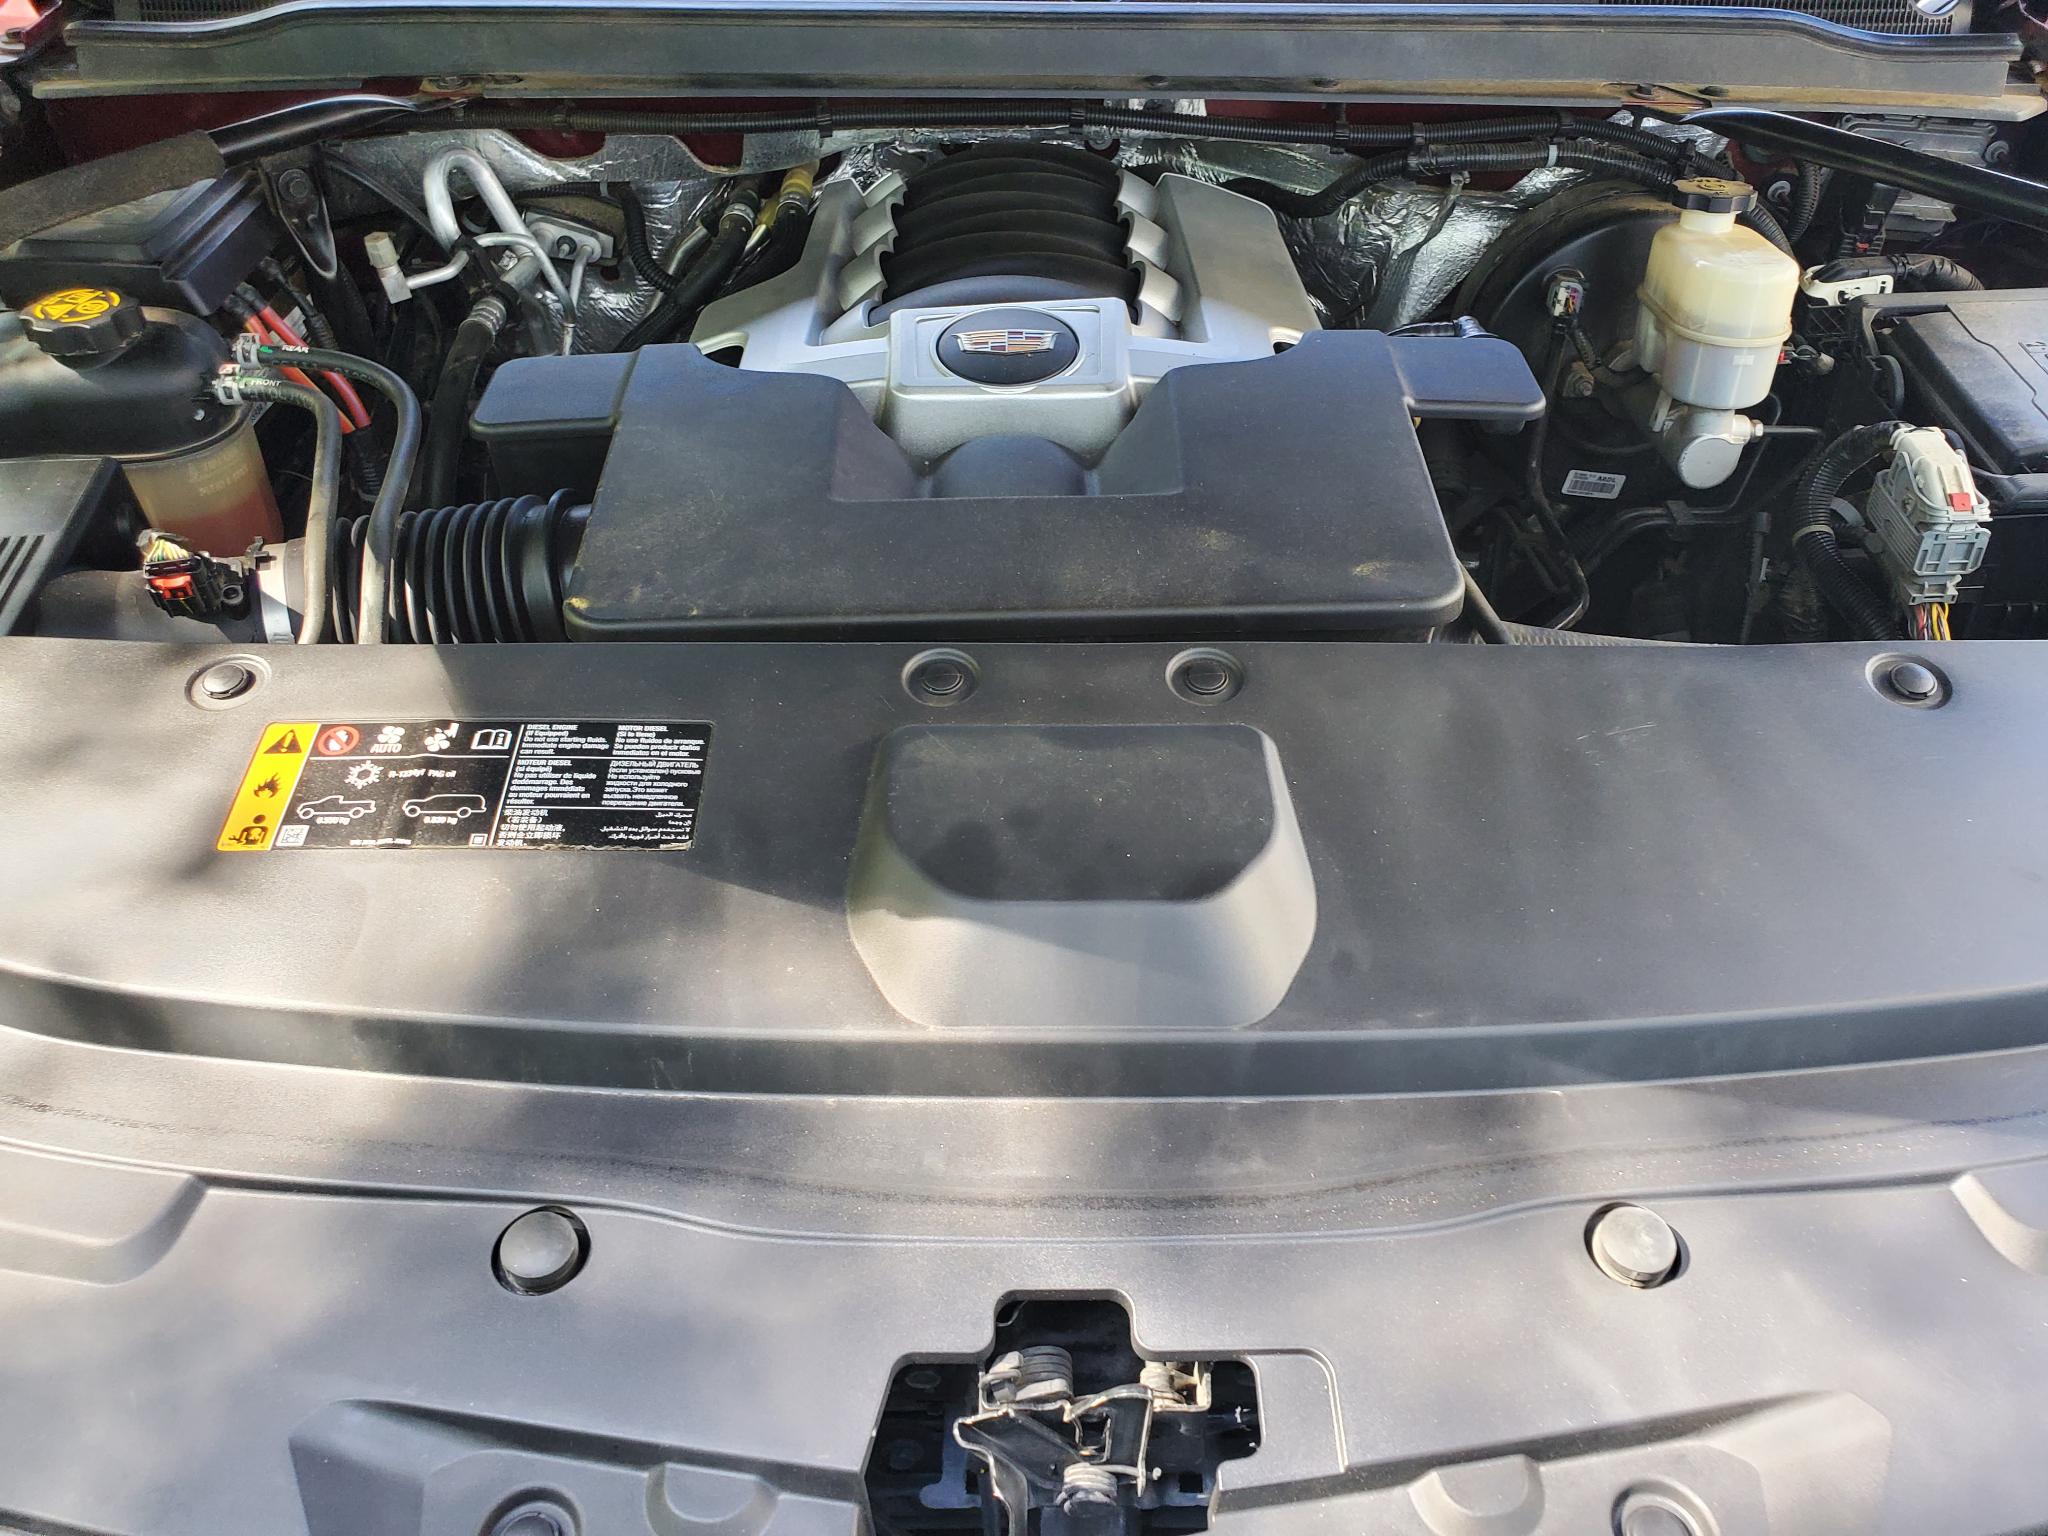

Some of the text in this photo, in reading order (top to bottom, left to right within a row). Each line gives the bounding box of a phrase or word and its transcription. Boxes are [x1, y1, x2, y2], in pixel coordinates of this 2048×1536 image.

[282, 344, 309, 353] REAR
[250, 379, 281, 387] FRONT
[370, 744, 402, 753] AUTO
